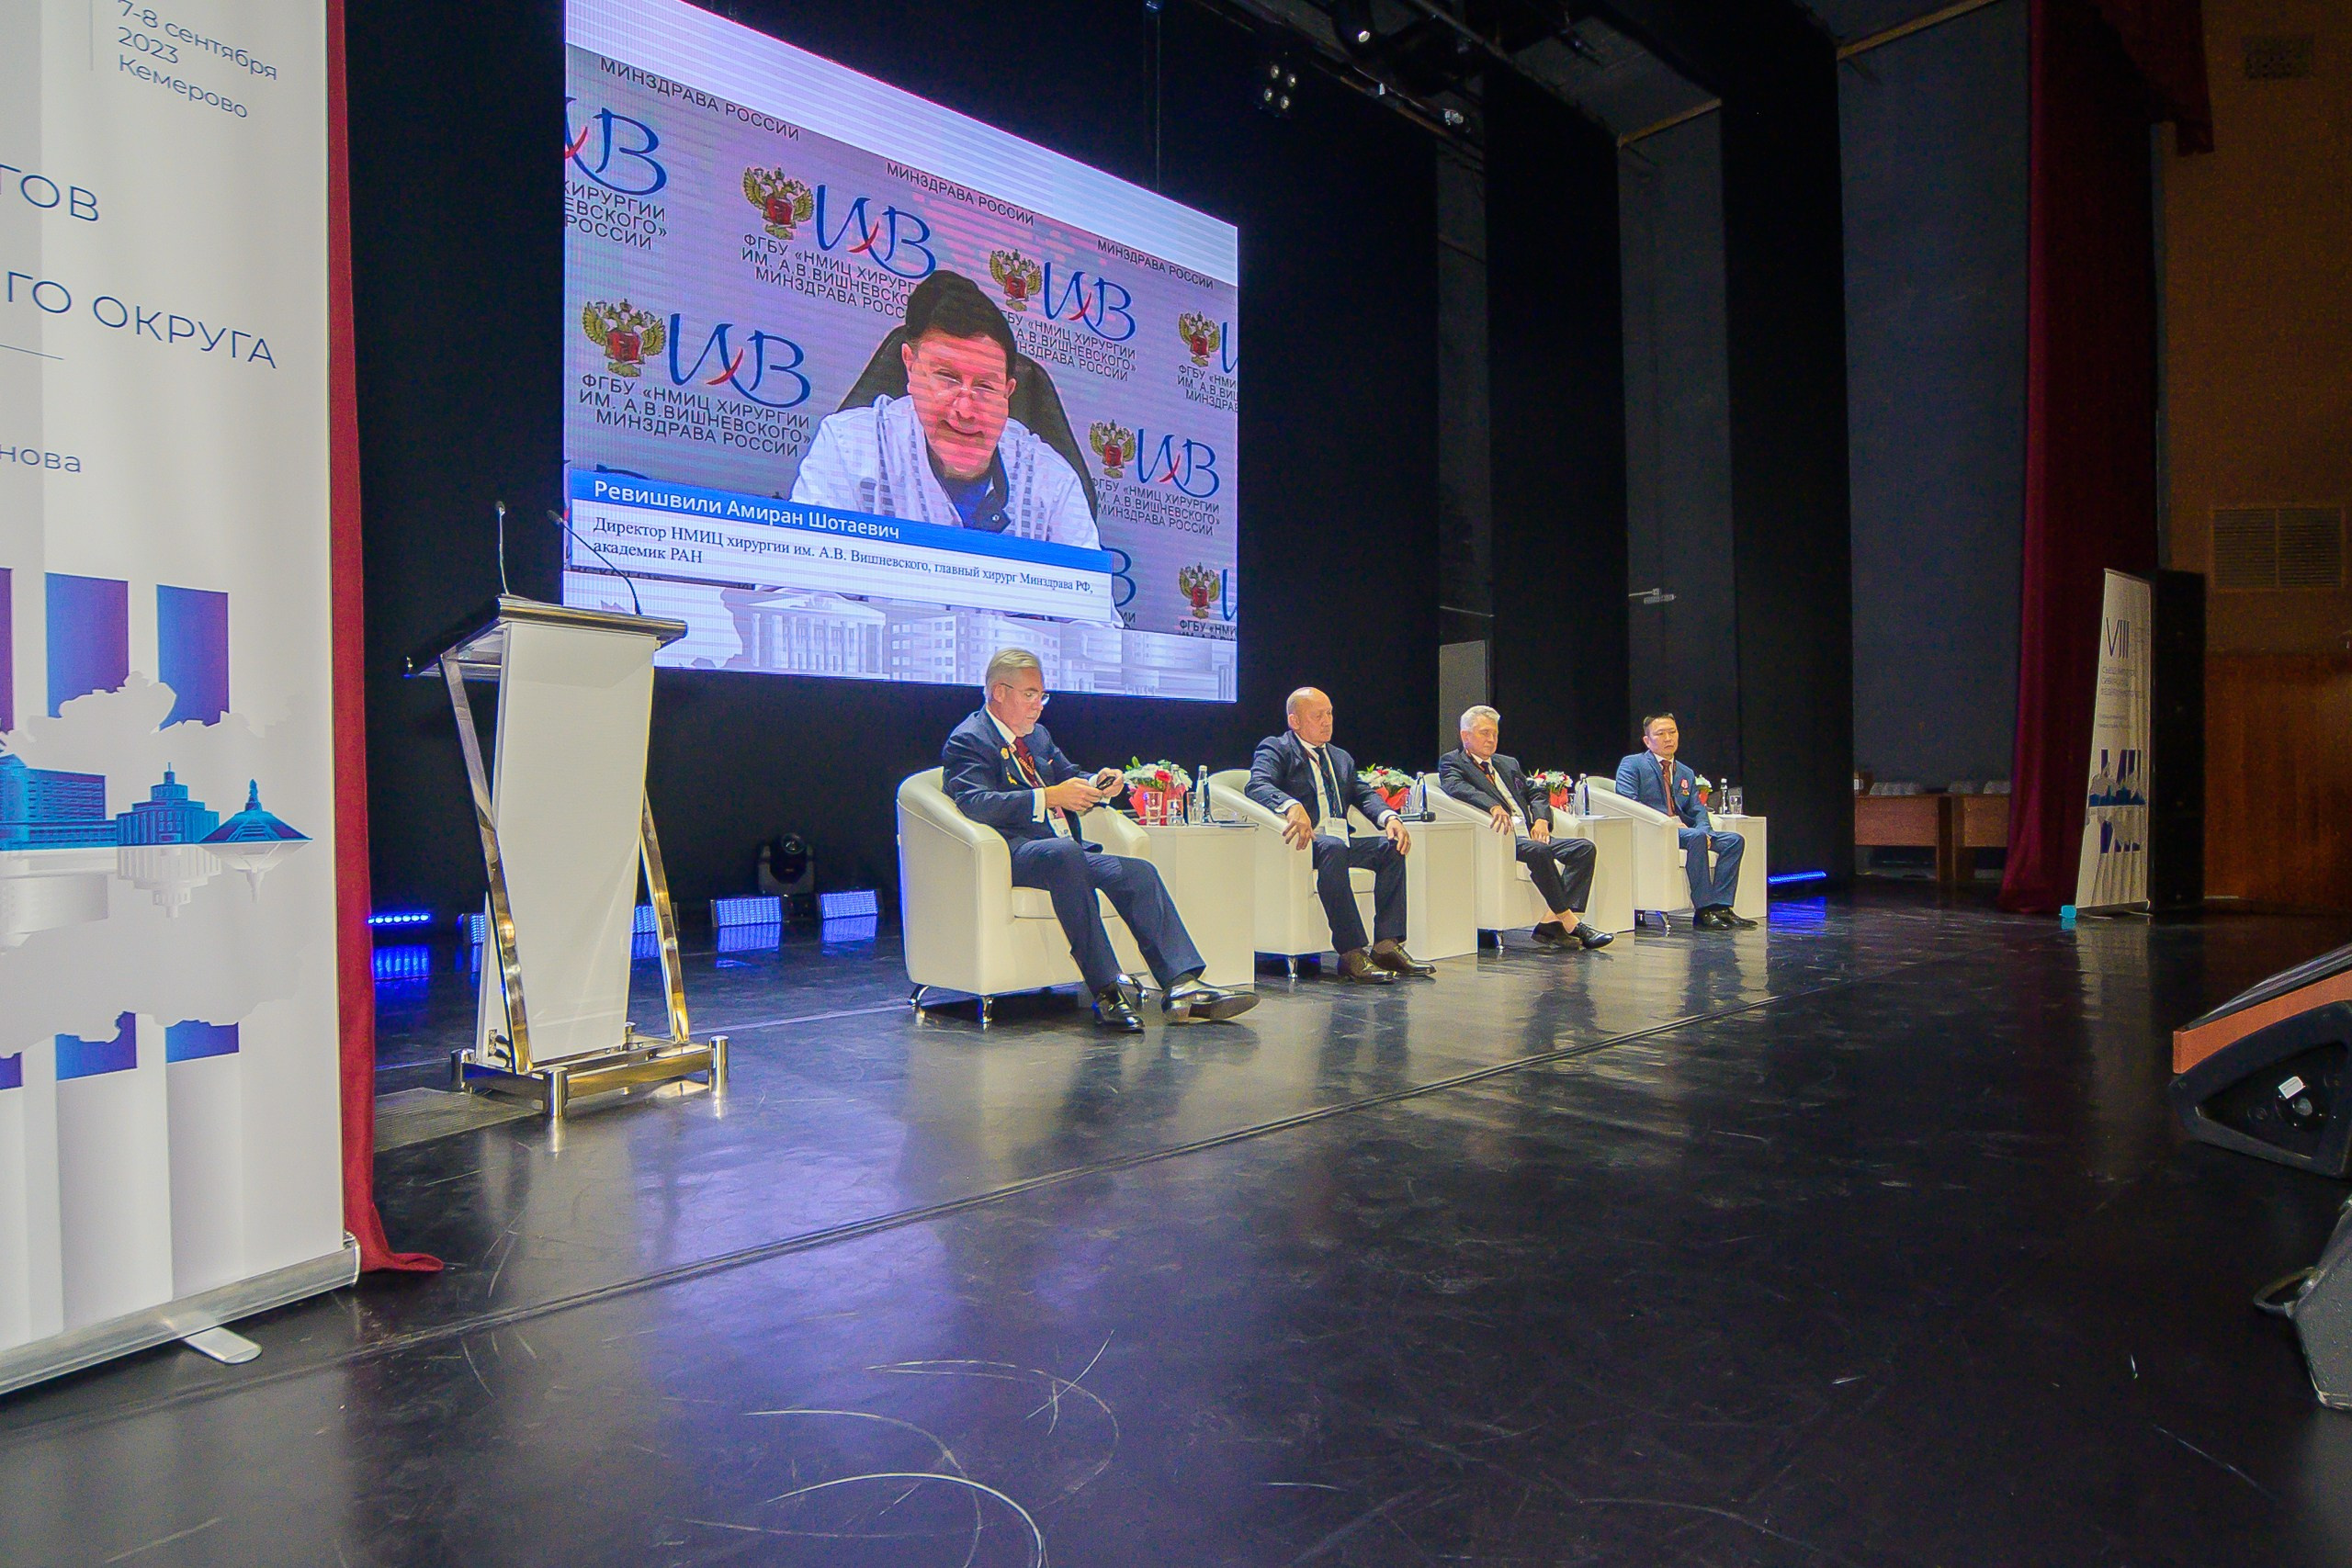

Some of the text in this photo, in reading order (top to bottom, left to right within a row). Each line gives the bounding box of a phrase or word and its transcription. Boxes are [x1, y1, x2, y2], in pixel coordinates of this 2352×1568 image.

[118, 0, 277, 80] 7-8 сентября
[119, 27, 178, 63] 2023
[119, 54, 247, 118] Кемерово
[601, 57, 799, 141] МИНЗДРАВА РОССИИ
[887, 162, 1035, 226] МИНЗДРАВА РОССИИ
[565, 214, 651, 250] РОССИИ
[743, 233, 788, 256] ФГБУ
[796, 250, 851, 276] «НМИЦ
[1098, 239, 1214, 289] МИНЗДРАВА РОССИИ
[755, 266, 857, 306] МИНЗДРАВА
[8, 271, 277, 368] ГО ОКРУГА
[1028, 320, 1070, 341] «НМИЦ
[1075, 332, 1136, 359] ХИРУРГИИ
[1016, 341, 1128, 381] НЗДРАВА РОССИИ
[1179, 365, 1205, 379] ФГБУ
[579, 389, 616, 409] ИМ.
[582, 374, 809, 429] ФГБУ «НМИЦ ХИРУРГИИ
[596, 409, 797, 457] МИНЗДРАВА РОССИИ
[594, 479, 899, 539] Ревишвили Амиран Шотаевич
[1098, 504, 1213, 536] МИНЗДРАВА РОССИИ
[1124, 485, 1161, 502] «НМИЦ
[1165, 493, 1219, 513] ХИРУРГИИ
[594, 542, 703, 563] академик РАН
[594, 516, 1093, 594] Директор НМИЦ хирургии им. А.В. Вишневского, главный хирург Минздрава РФ,
[1180, 620, 1205, 632] ФГБУ
[2106, 616, 2130, 660] VIII
